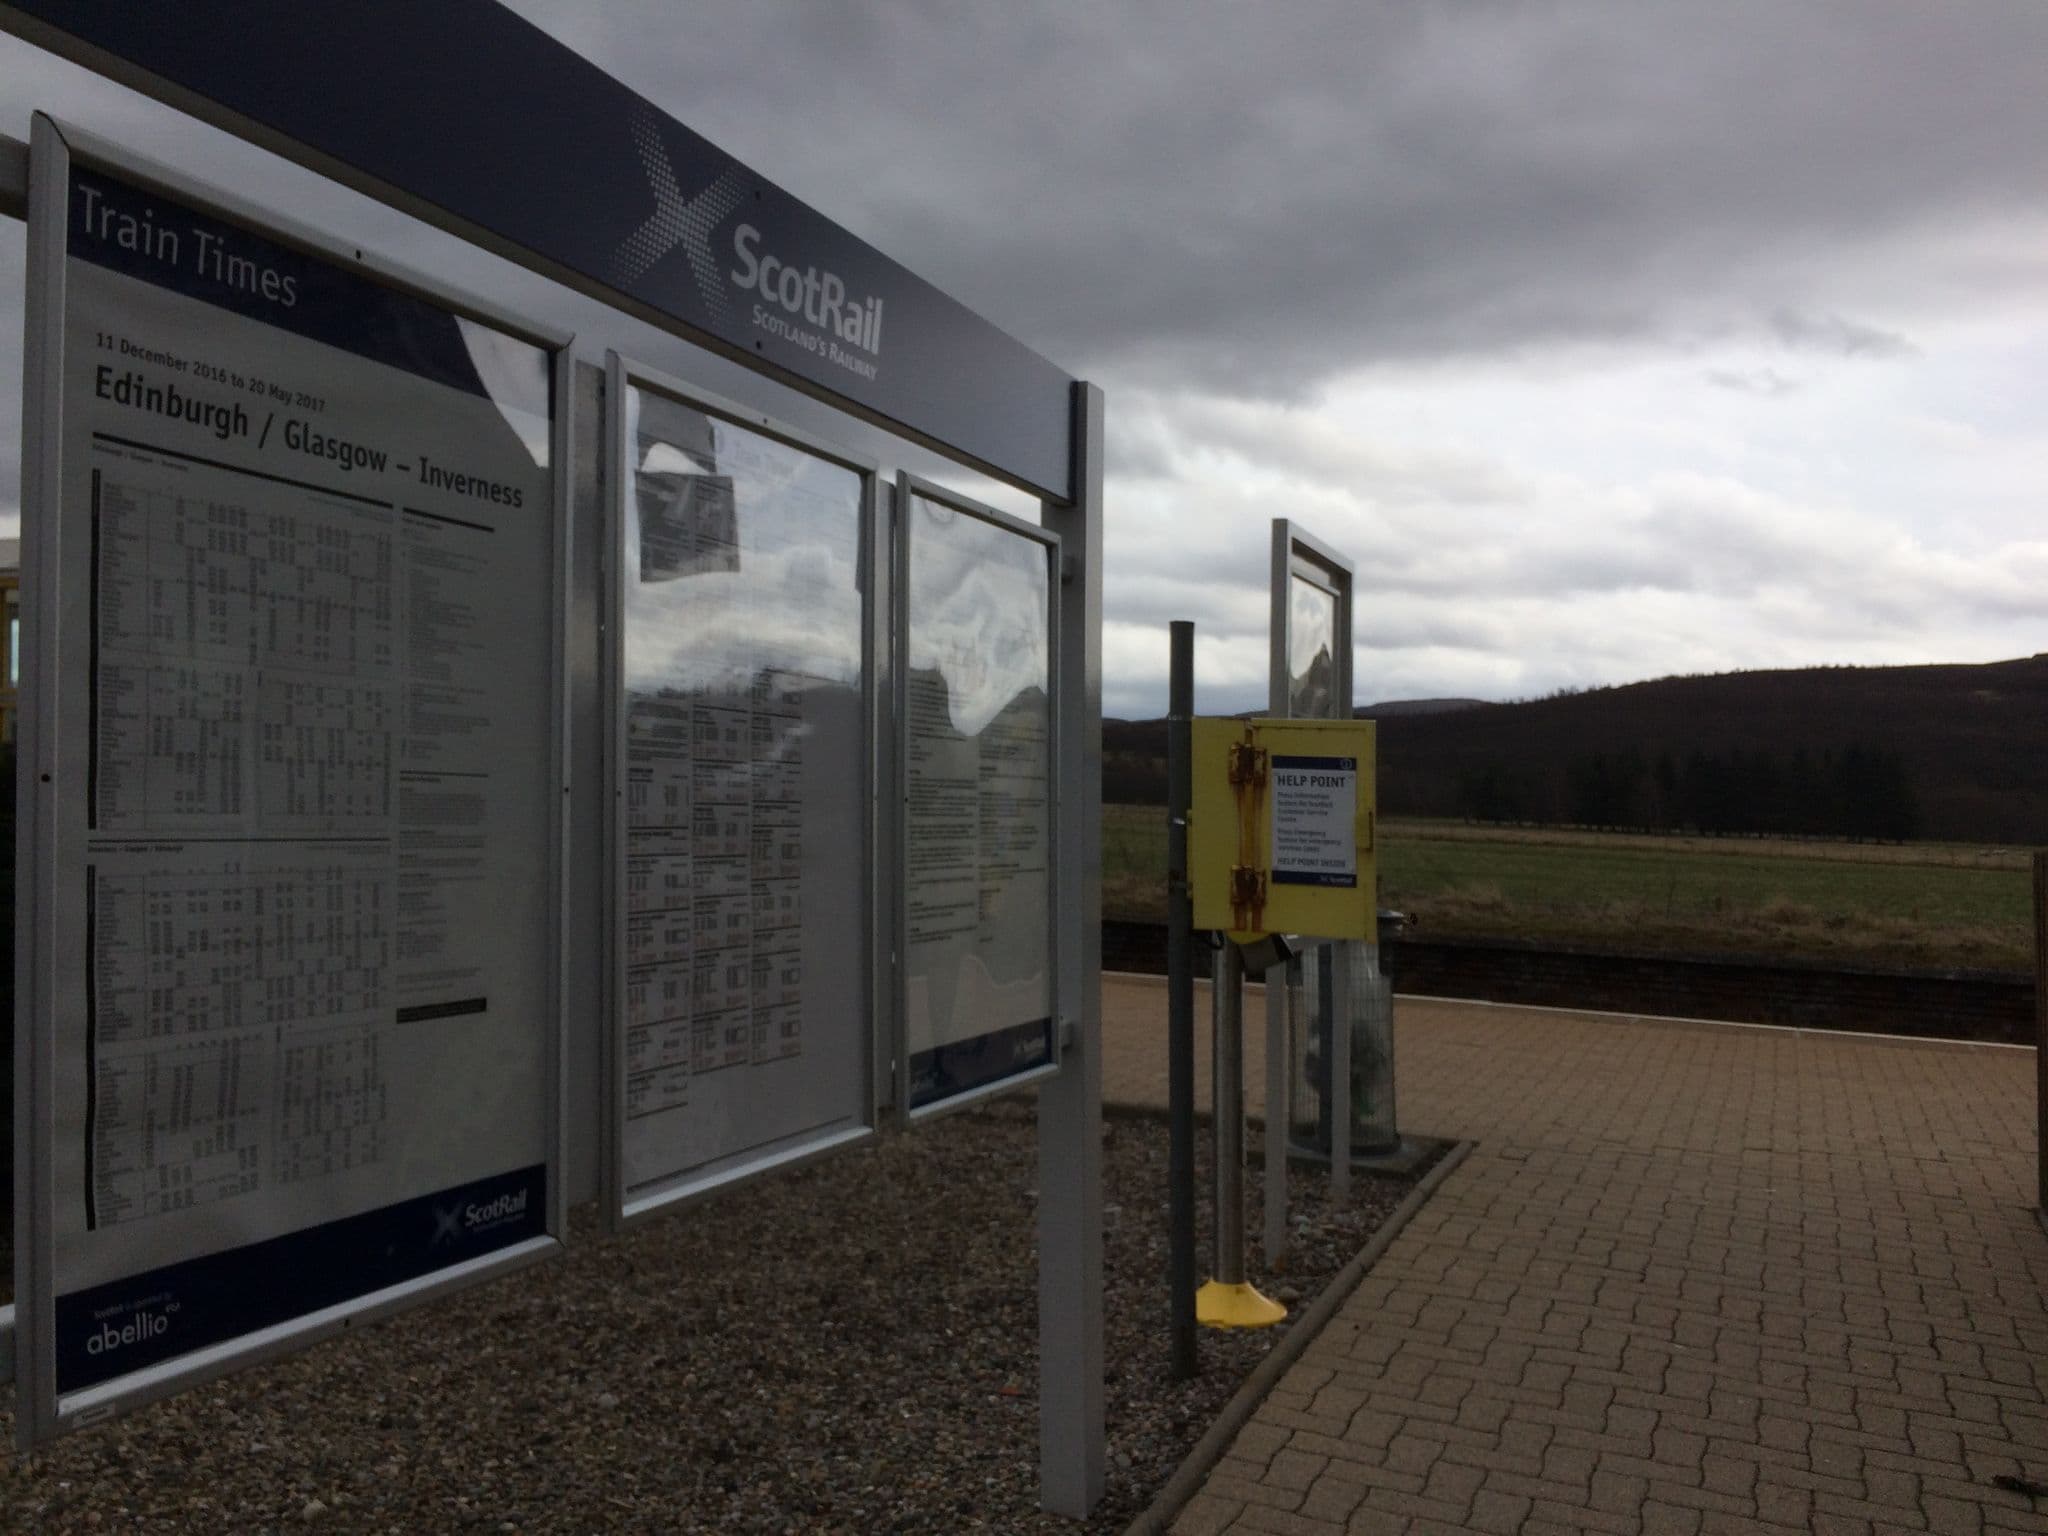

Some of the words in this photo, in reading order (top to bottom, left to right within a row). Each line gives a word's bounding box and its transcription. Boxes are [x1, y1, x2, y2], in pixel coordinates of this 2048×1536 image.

[77, 183, 180, 265] Train
[193, 229, 299, 309] Times
[731, 223, 883, 355] ScotRail
[96, 332, 113, 351] 11
[120, 338, 188, 373] December
[193, 361, 227, 384] 2016
[231, 373, 245, 389] to
[249, 378, 265, 395] 20
[268, 383, 293, 406] May
[296, 391, 326, 413] 2017
[95, 364, 248, 440] Edinburgh
[258, 412, 275, 449] /
[284, 419, 387, 472] Glasgow
[419, 456, 523, 509] Inverness
[1277, 775, 1307, 787] HELP
[1310, 776, 1346, 788] POINT
[464, 1187, 528, 1227] ScotRail
[87, 1312, 168, 1355] abellio
